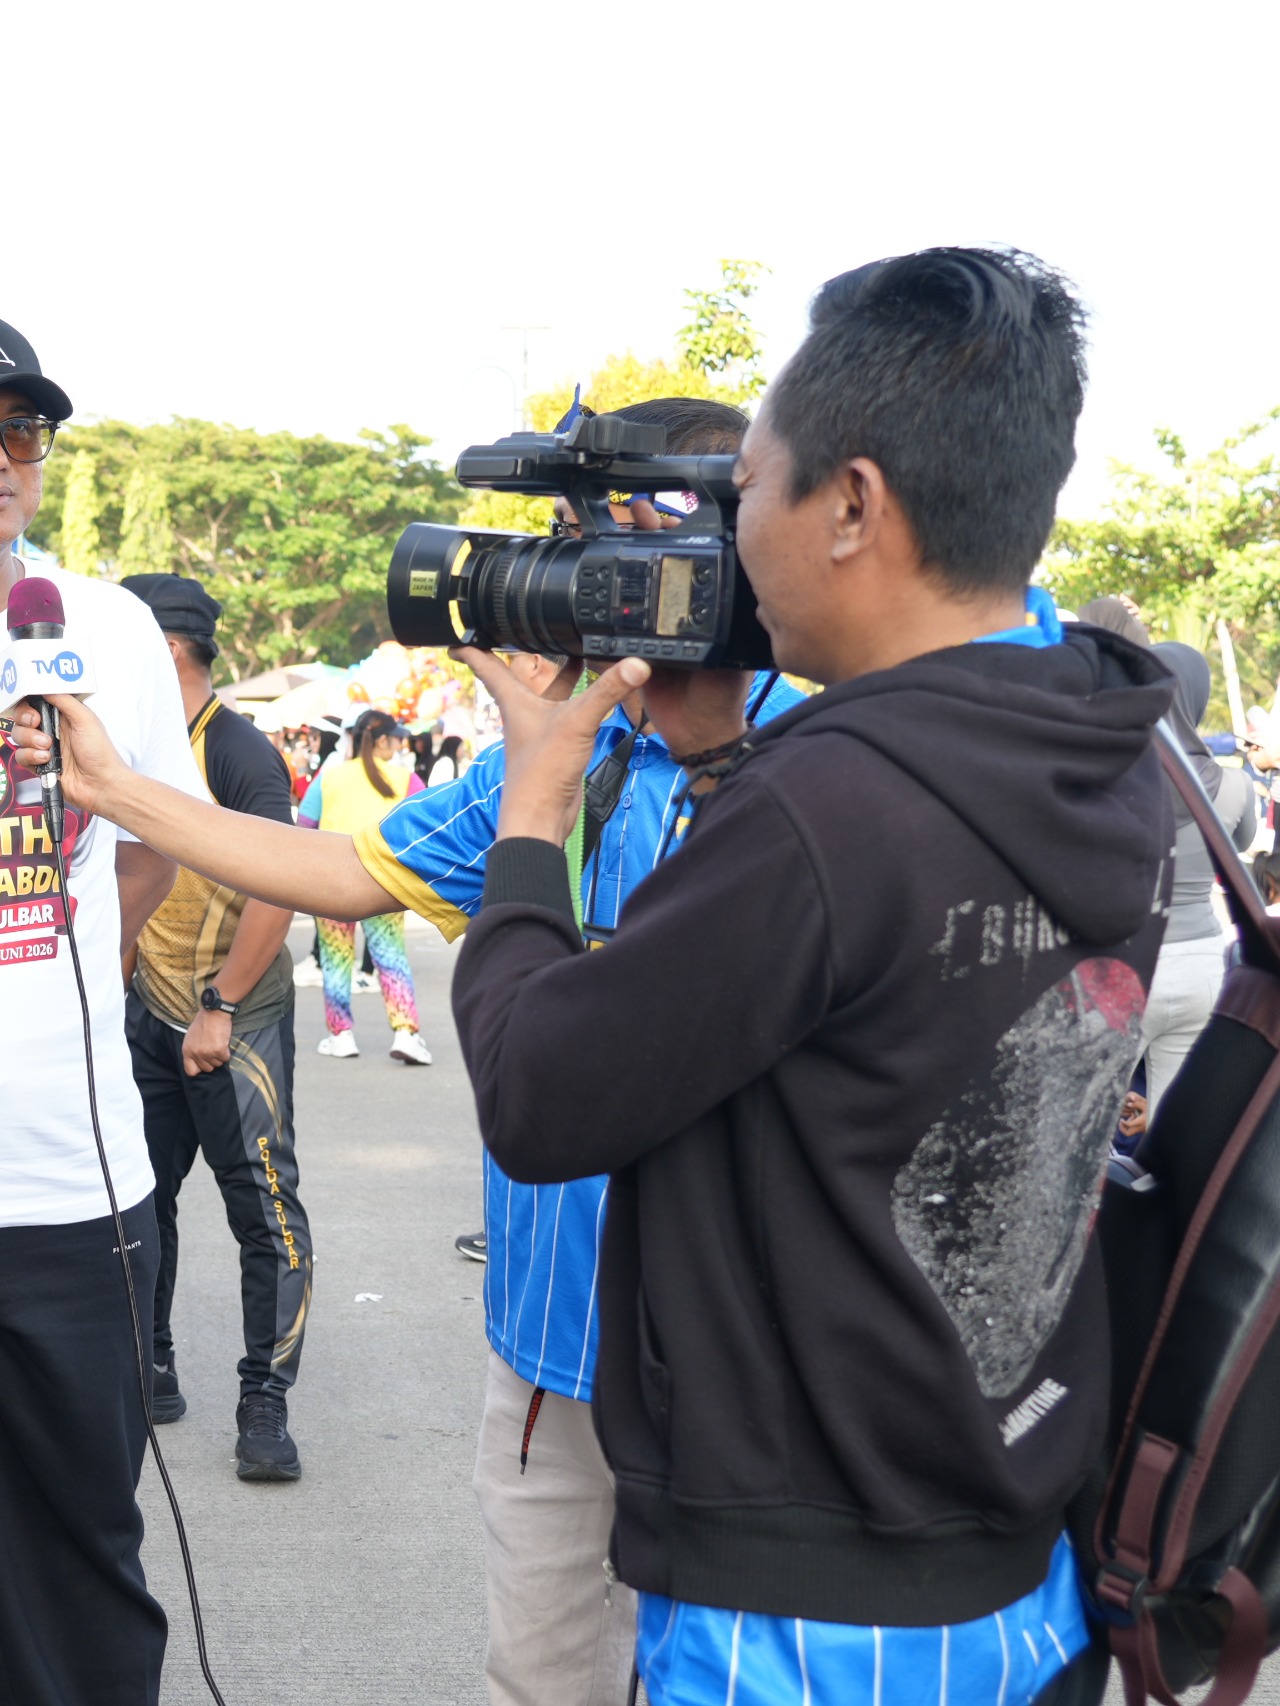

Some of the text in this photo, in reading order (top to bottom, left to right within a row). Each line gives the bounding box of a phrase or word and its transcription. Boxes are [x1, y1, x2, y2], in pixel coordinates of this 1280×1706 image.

[31, 655, 81, 678] TVRI
[26, 942, 54, 958] 2026
[256, 1136, 300, 1270] POLDA SULBAR
